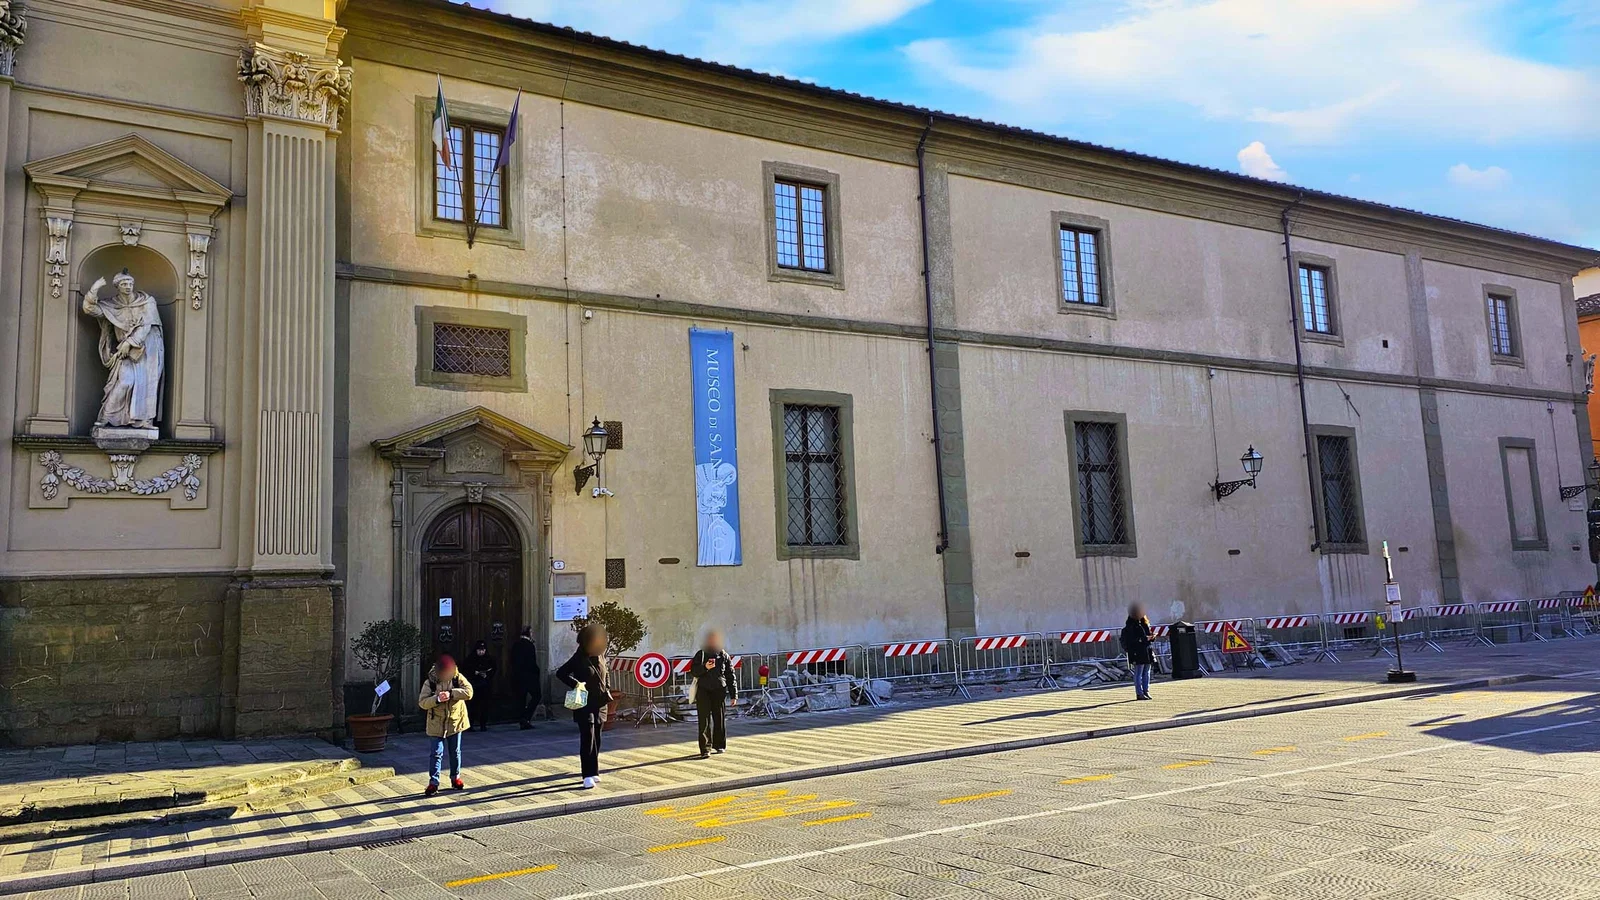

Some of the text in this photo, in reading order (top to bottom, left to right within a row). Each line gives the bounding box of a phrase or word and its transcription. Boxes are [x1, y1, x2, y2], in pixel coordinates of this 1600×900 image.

[706, 348, 721, 412] MUSEO
[709, 417, 717, 428] DI
[643, 662, 662, 678] 30
